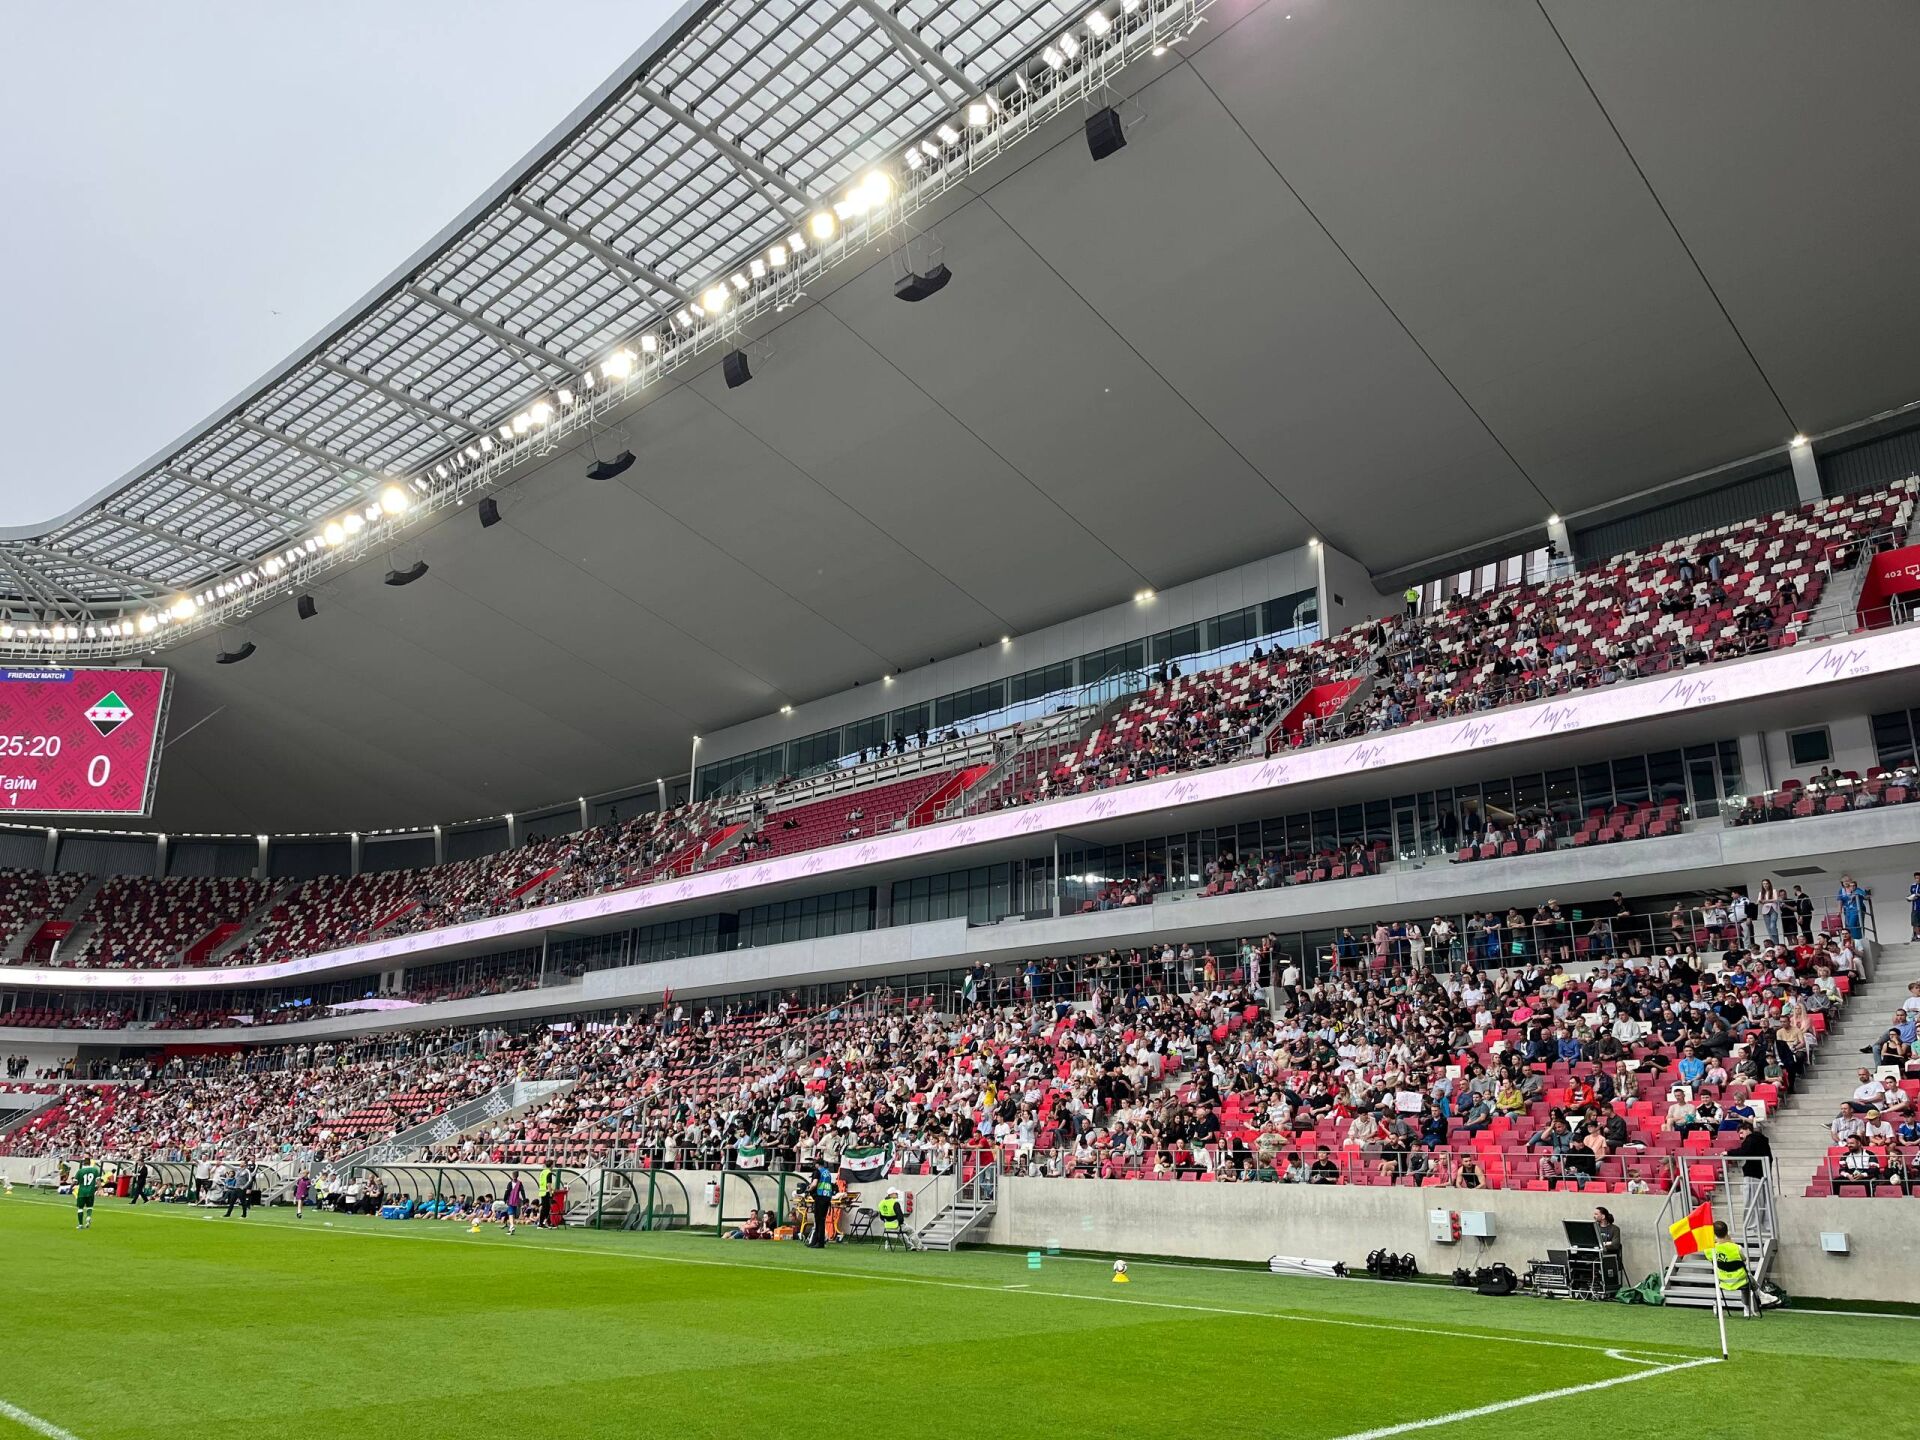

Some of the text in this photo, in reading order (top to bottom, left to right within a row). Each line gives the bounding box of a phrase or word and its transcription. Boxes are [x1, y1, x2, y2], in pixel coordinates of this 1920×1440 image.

[1884, 570, 1902, 579] 402
[1849, 665, 1870, 675] 1953
[41, 672, 66, 680] MATCH
[1698, 694, 1716, 704] 1953
[1563, 721, 1580, 729] 1953
[0, 735, 61, 757] 25:20
[1482, 737, 1498, 745] 1953
[87, 755, 111, 787] 0
[9, 793, 18, 806] 1
[83, 1172, 95, 1186] 19
